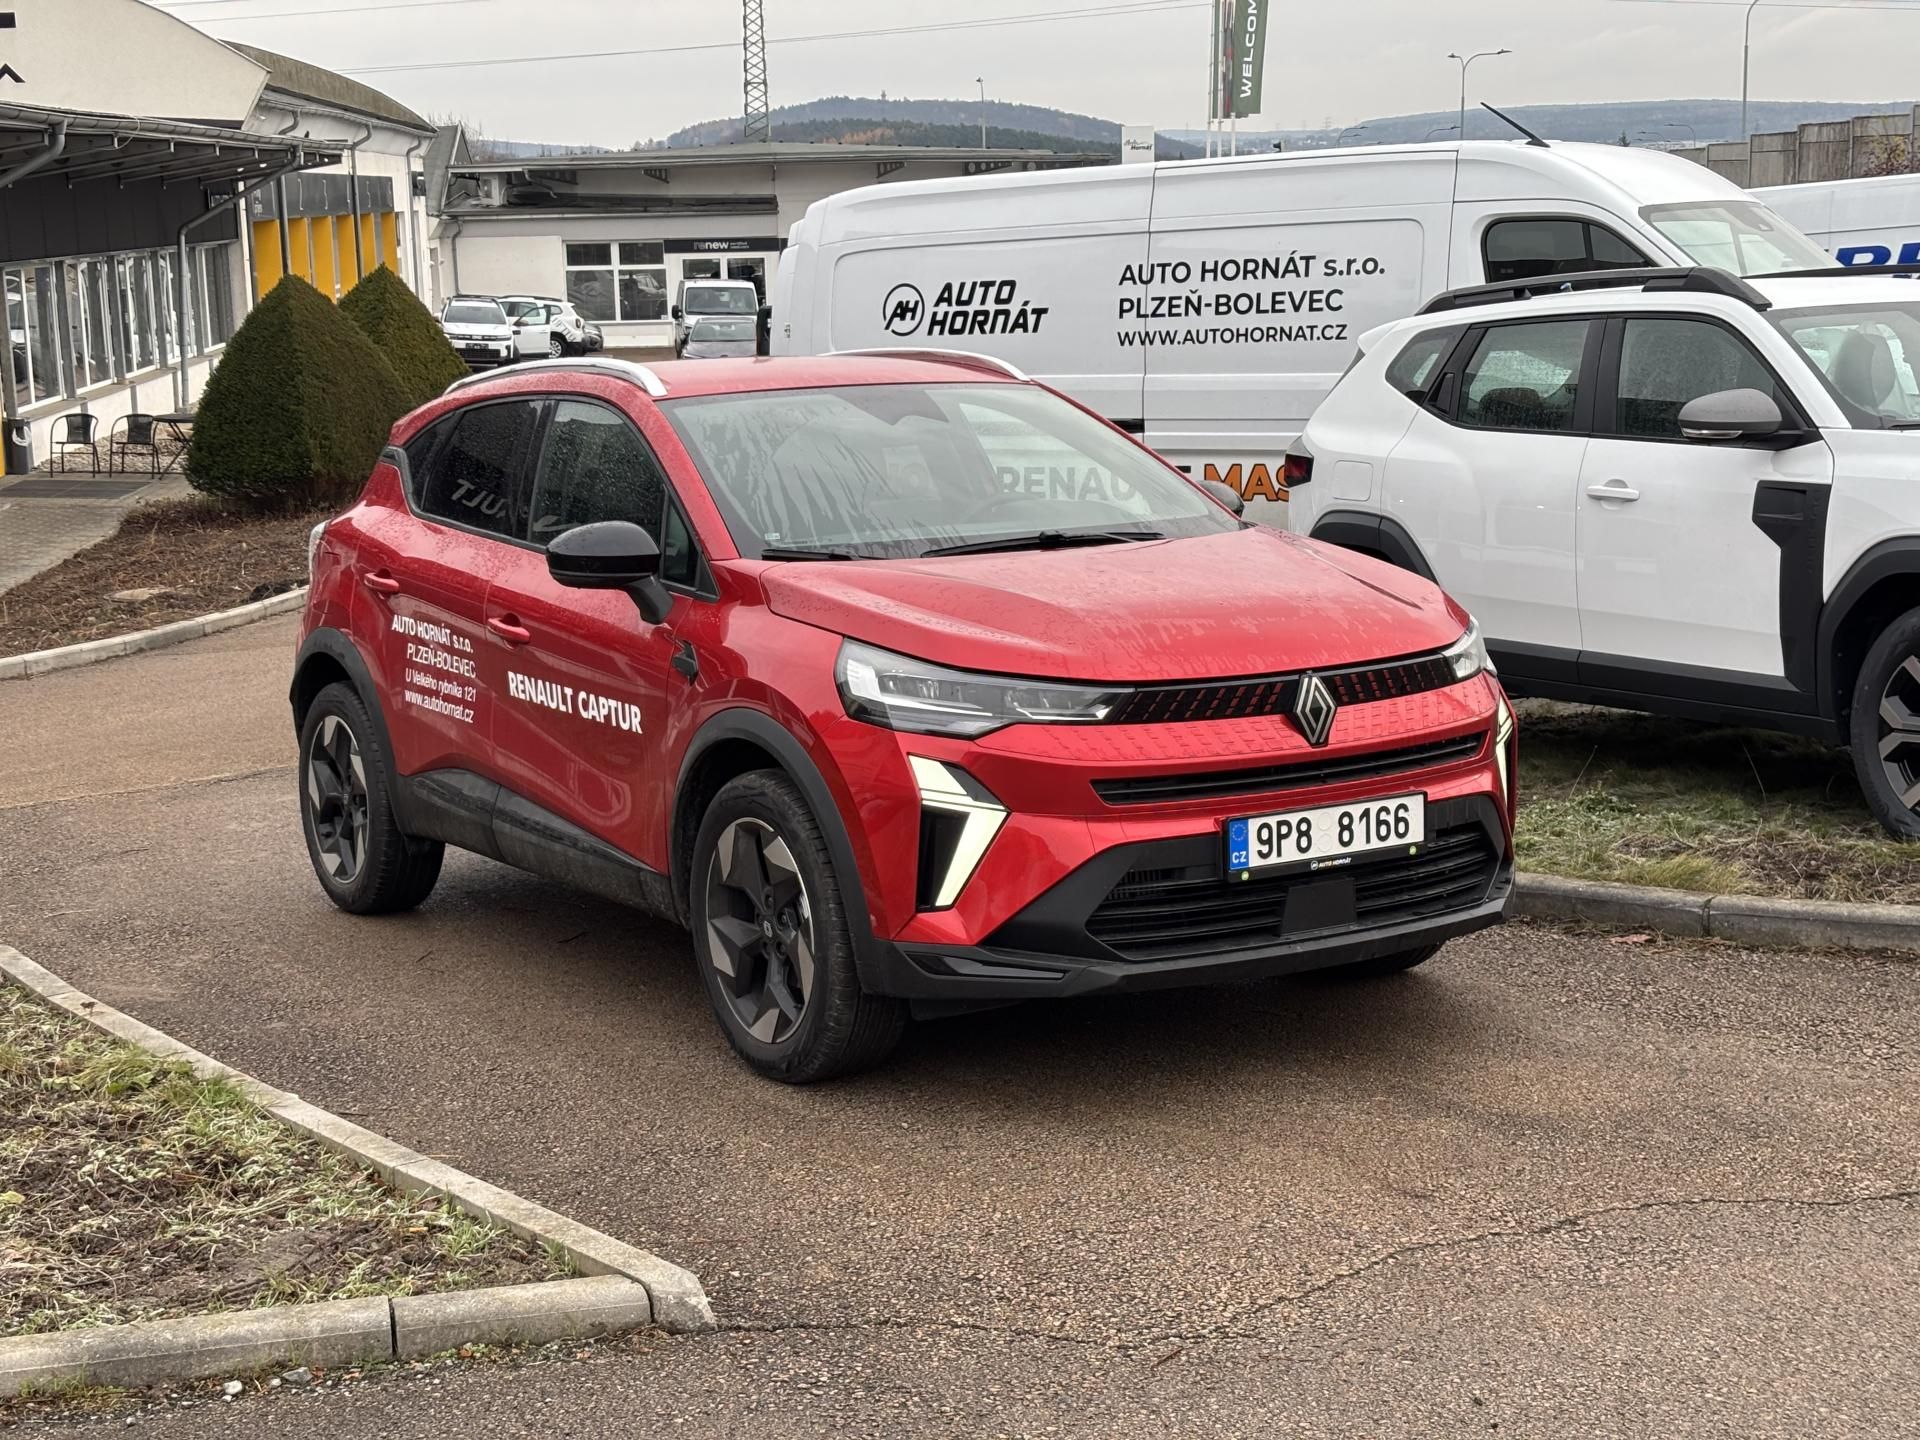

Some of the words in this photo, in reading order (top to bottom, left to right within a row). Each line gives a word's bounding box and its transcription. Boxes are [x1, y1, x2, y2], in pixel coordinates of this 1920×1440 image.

[693, 241, 729, 250] renew
[1118, 262, 1191, 286] AUTO
[1200, 250, 1316, 282] HORNÁT
[1323, 256, 1385, 277] s.r.o.
[933, 279, 1017, 307] AUTO
[1118, 288, 1344, 319] PLZEŇ-BOLEVEC
[927, 300, 1049, 336] HORNÁT
[1117, 324, 1348, 347] WWW.AUTOHORNAT.CZ
[392, 615, 415, 636] AUTO
[417, 620, 451, 646] HORNÁT
[453, 635, 474, 653] s.r.o.
[407, 643, 476, 678] PLZEŇ-BOLEVEC
[405, 668, 412, 682] U
[464, 686, 476, 702] 121
[405, 690, 474, 723] www.autohornat.cz
[508, 671, 573, 714] RENAULT
[578, 691, 643, 734] CAPTUR
[1232, 851, 1247, 864] CZ
[1256, 817, 1312, 860] 9P8
[1338, 803, 1410, 848] 8166
